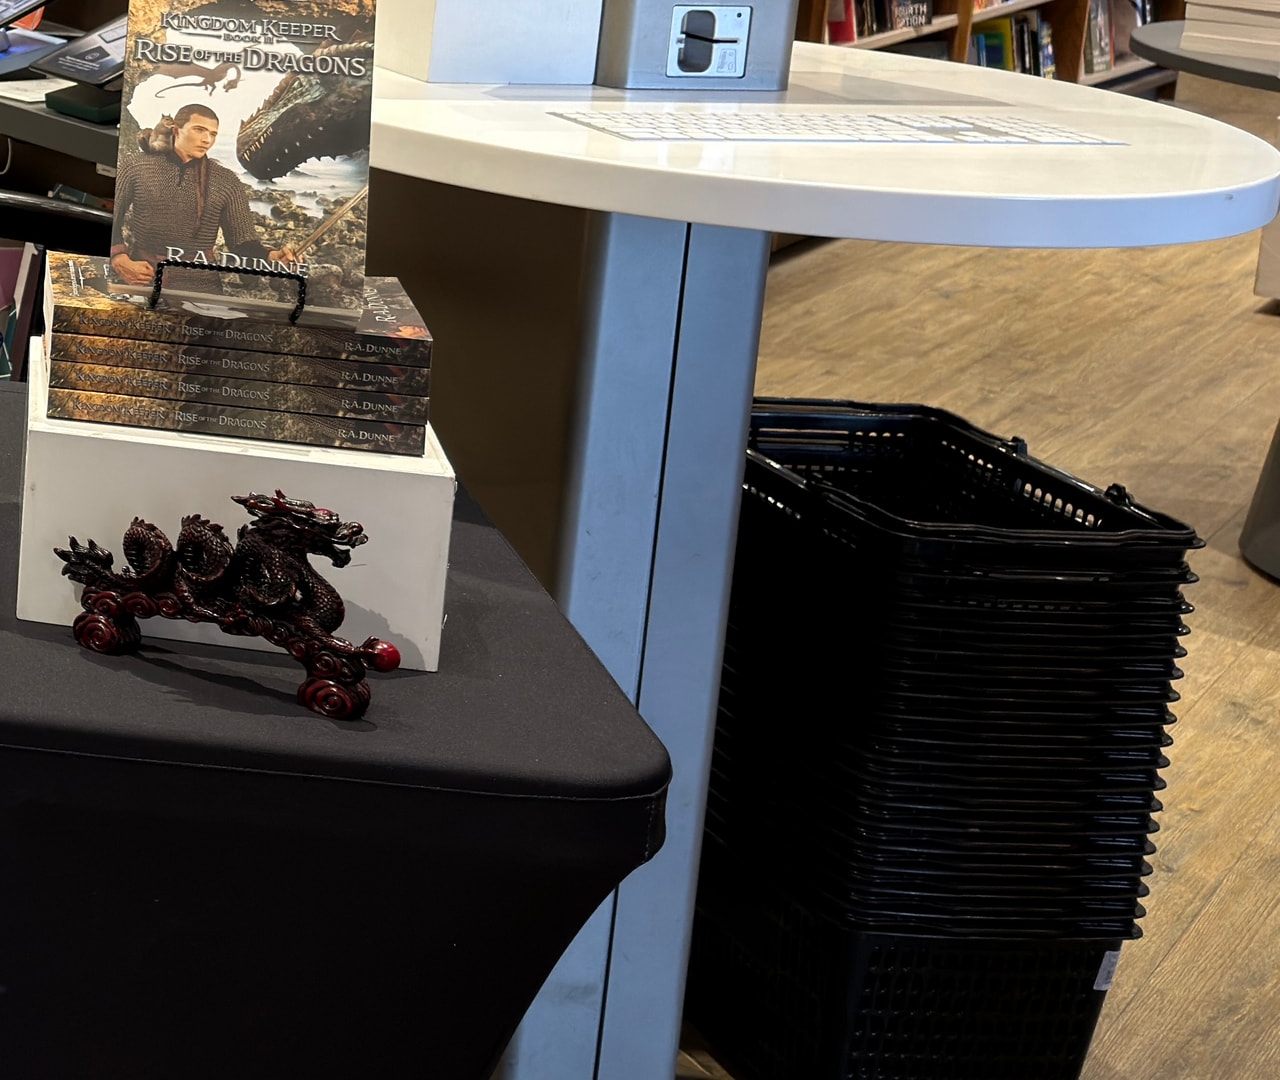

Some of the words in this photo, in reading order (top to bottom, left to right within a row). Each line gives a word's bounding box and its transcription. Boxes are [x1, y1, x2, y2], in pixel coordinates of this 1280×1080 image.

[161, 12, 257, 33] KINGDOM
[261, 20, 342, 41] KEEPER
[135, 38, 193, 63] RISE
[194, 48, 211, 60] OF
[213, 52, 241, 63] THE
[244, 48, 366, 77] DRAGONS
